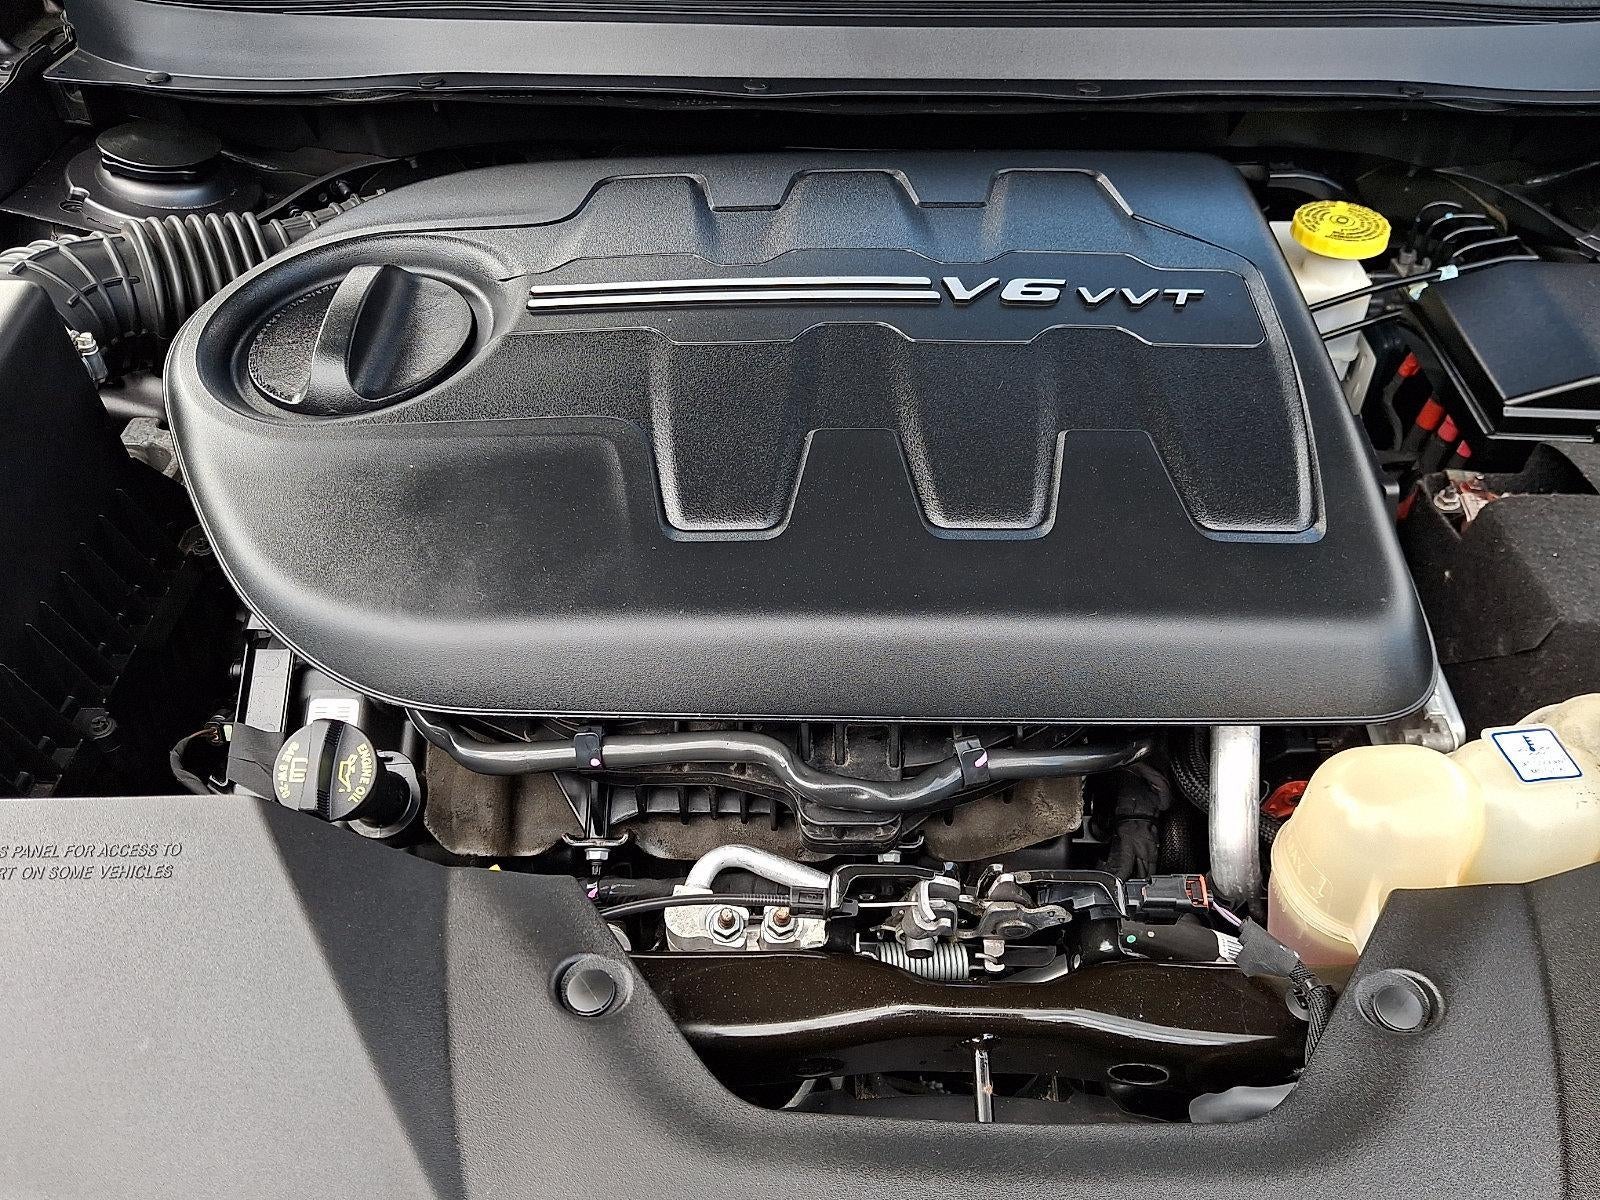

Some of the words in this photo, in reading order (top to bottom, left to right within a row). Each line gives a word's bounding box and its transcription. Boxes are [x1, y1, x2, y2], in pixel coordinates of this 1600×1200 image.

[941, 276, 1067, 303] V6
[1076, 287, 1205, 306] VVT
[356, 743, 373, 785] ENGINE
[347, 786, 366, 803] OIL
[11, 844, 60, 859] PANEL
[64, 844, 96, 858] FOR
[97, 843, 160, 858] ACCESS
[162, 842, 183, 857] TO
[21, 866, 46, 880] ON
[49, 865, 95, 880] SOME
[100, 864, 175, 879] VEHICLES
